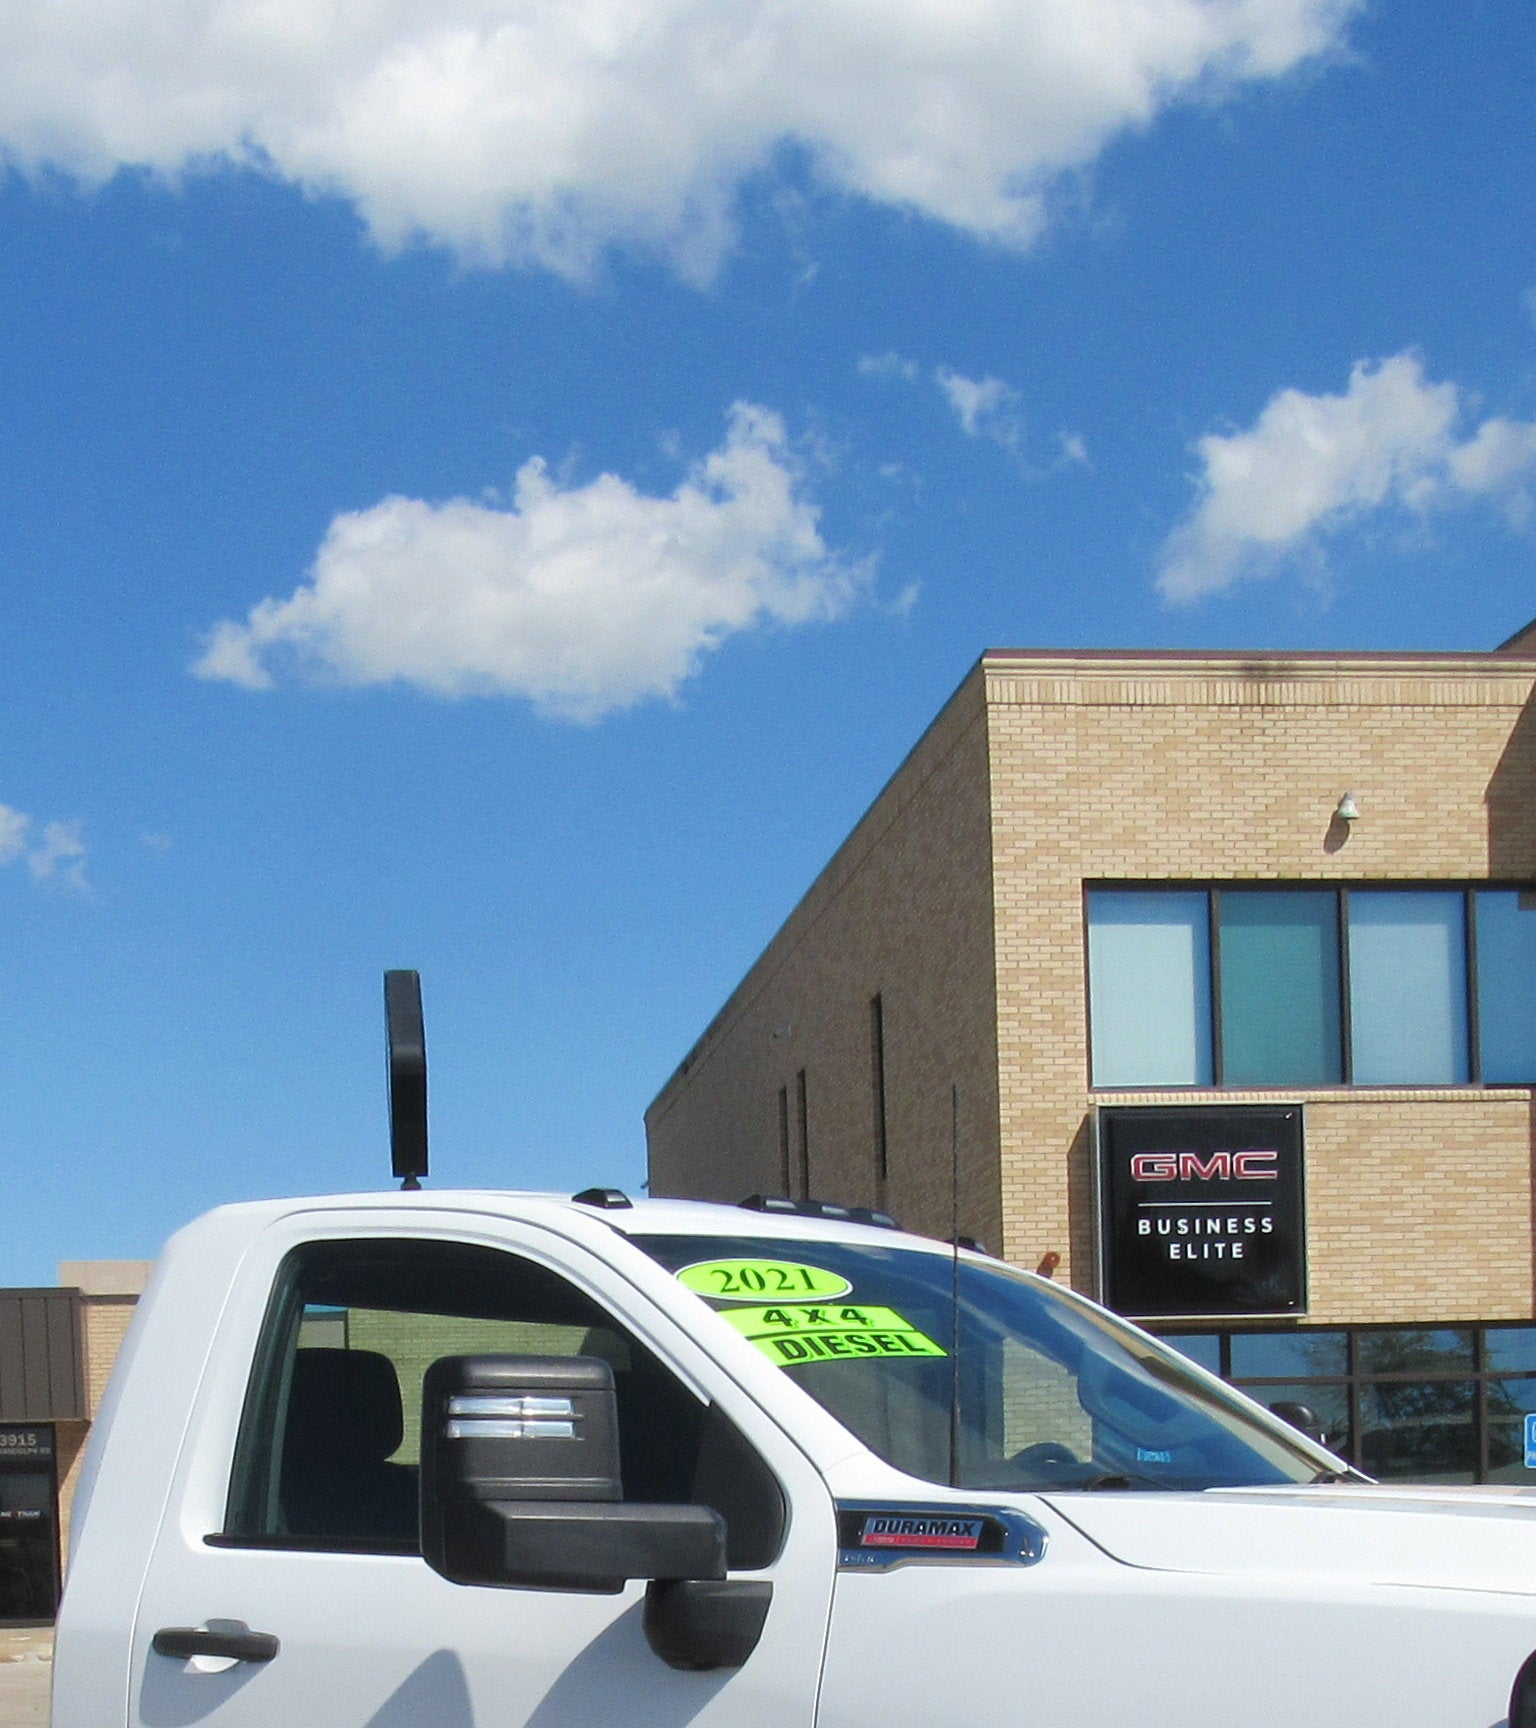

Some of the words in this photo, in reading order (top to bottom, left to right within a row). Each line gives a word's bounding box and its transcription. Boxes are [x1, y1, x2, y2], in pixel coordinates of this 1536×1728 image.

[1130, 1150, 1278, 1181] GMC
[1137, 1217, 1274, 1235] BUSINESS
[1169, 1242, 1245, 1260] ELITE
[711, 1267, 818, 1294] 2021
[772, 1334, 928, 1361] DIESEL
[873, 1519, 976, 1536] DURAMAX
